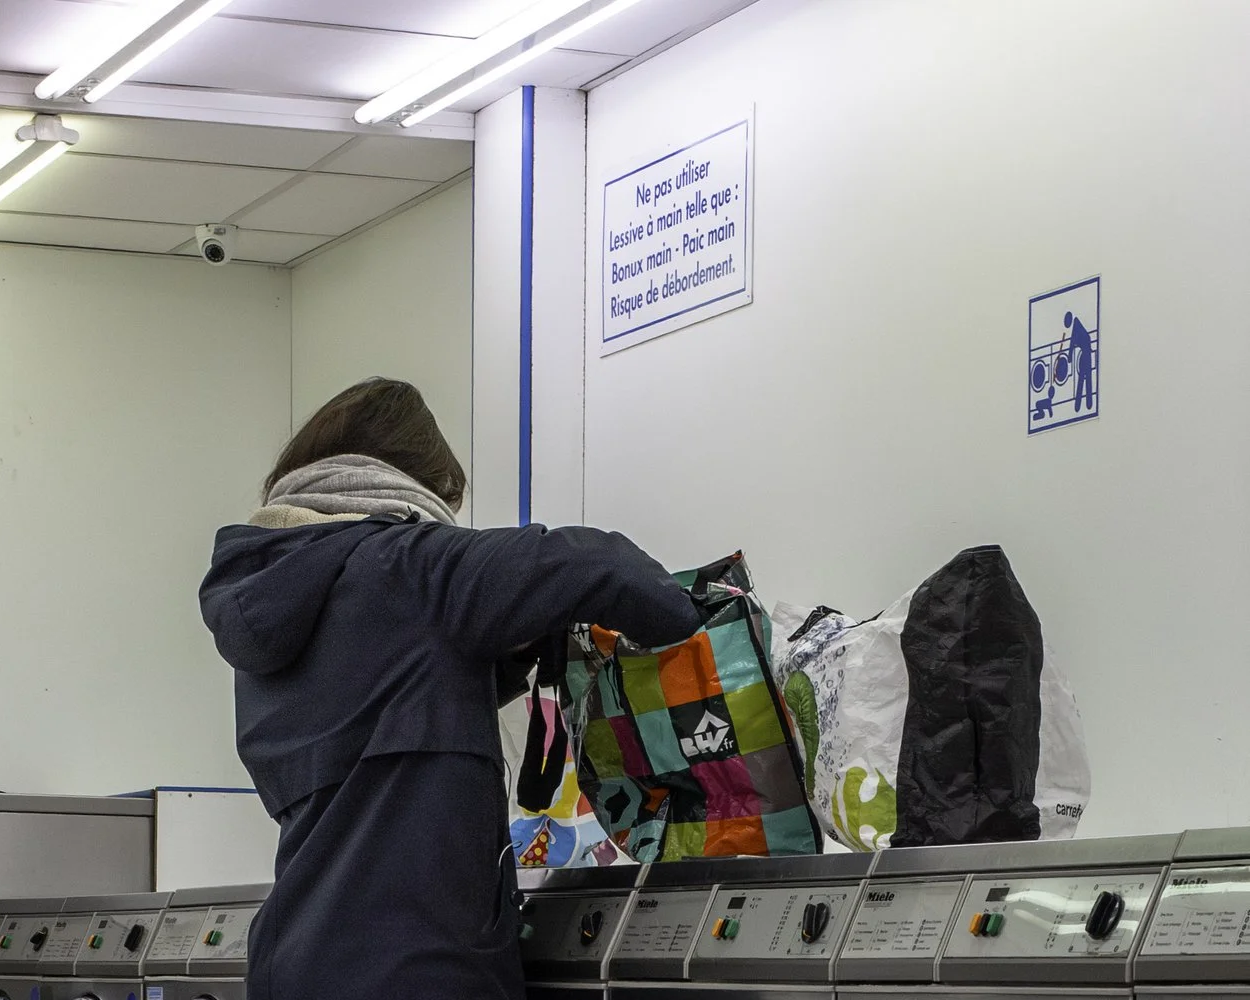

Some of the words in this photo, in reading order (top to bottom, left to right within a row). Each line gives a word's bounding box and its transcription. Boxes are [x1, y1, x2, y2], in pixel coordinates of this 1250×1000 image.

[636, 183, 651, 207] Ne
[654, 178, 672, 207] pas
[675, 160, 710, 190] utiliser
[609, 222, 644, 252] Lessive
[646, 215, 653, 236] à
[657, 203, 682, 233] main
[685, 190, 707, 220] telle
[711, 187, 731, 215] que
[612, 258, 643, 284] Bonux
[646, 242, 671, 271] main
[683, 228, 704, 256] Paic
[708, 216, 735, 247] main
[611, 289, 643, 319] Risque
[646, 279, 659, 305] de
[662, 253, 735, 299] débordement.
[1056, 802, 1083, 818] carref
[867, 891, 895, 902] Miele
